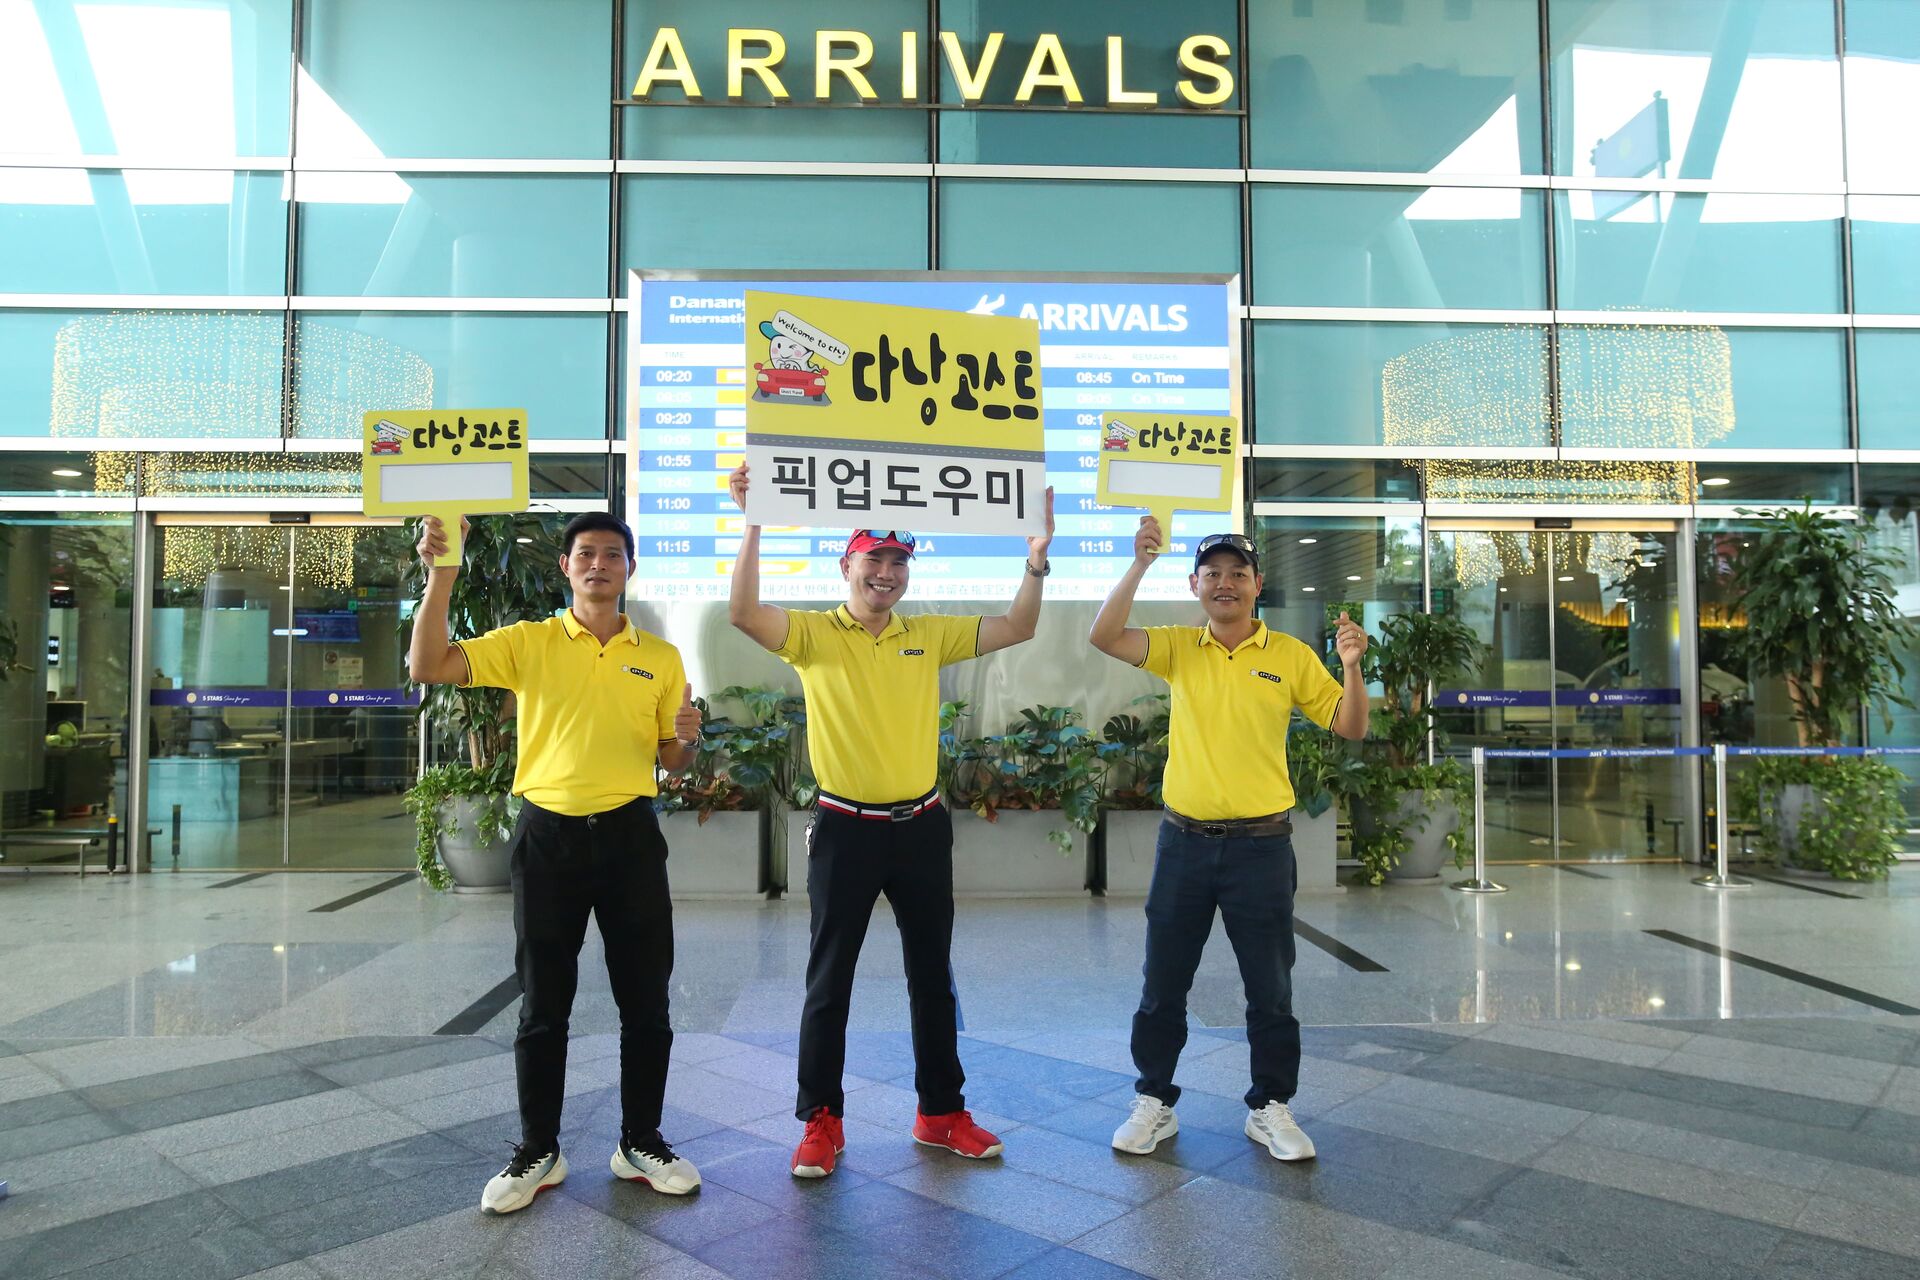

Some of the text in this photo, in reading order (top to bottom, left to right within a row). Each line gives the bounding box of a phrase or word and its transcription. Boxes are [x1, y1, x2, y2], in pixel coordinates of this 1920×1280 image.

[632, 27, 1234, 106] ARRIVALS
[1018, 303, 1188, 332] ARRIVALS
[778, 317, 815, 342] Welcome
[817, 339, 827, 348] to
[656, 370, 692, 382] 09:20
[852, 332, 1039, 426] 다낭고스트
[1076, 371, 1185, 384] 08:45 On Time
[1131, 392, 1152, 405] On
[656, 412, 692, 425] 09:20
[1076, 413, 1103, 426] 09:1
[413, 416, 522, 456] 다낭고스트
[1138, 421, 1232, 456] 다낭고스트
[656, 454, 692, 467] 10:55
[771, 456, 1025, 519] 픽업도우미
[656, 498, 691, 510] 11:00
[656, 541, 690, 553] 11:15
[818, 540, 848, 553] PR5
[1079, 541, 1113, 553] 11:15
